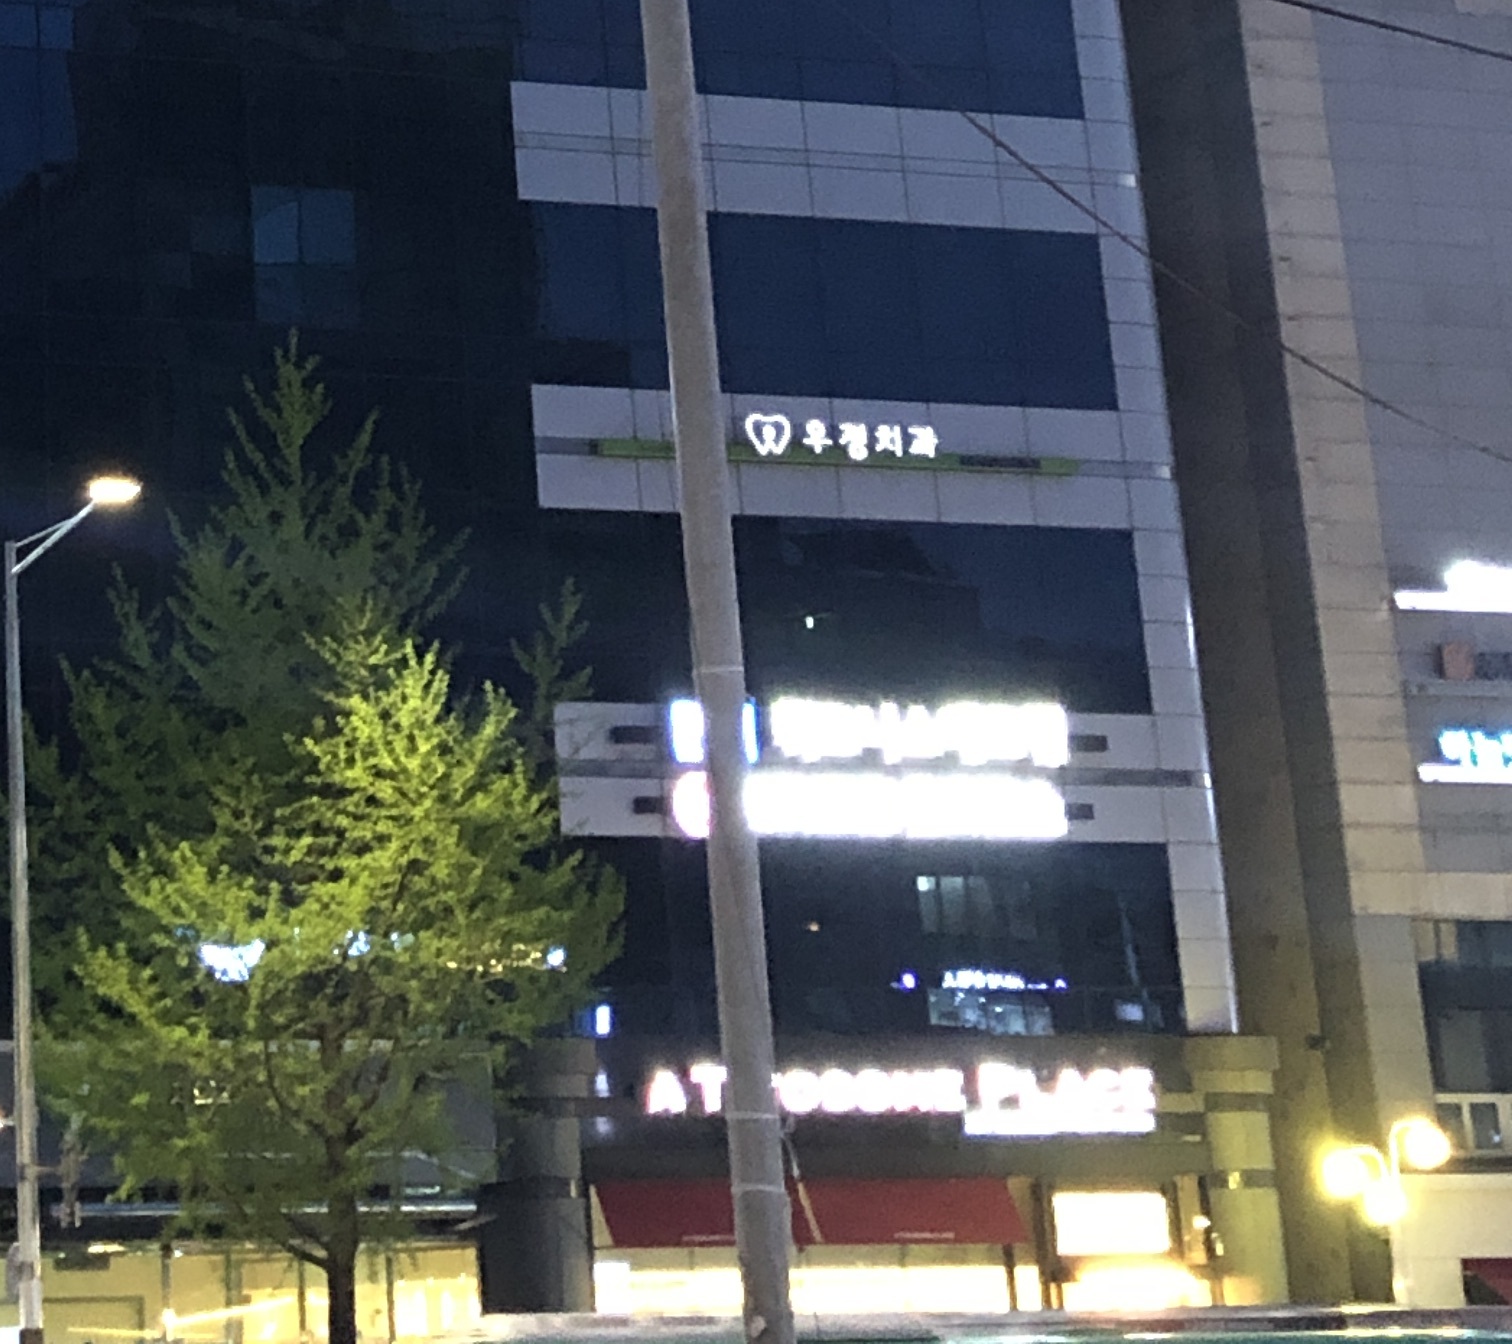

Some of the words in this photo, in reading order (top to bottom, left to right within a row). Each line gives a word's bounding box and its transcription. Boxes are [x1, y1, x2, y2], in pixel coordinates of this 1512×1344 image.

[646, 1069, 687, 1115] A
[689, 1062, 967, 1115] TOSOME
[975, 1061, 1155, 1115] PLACE
